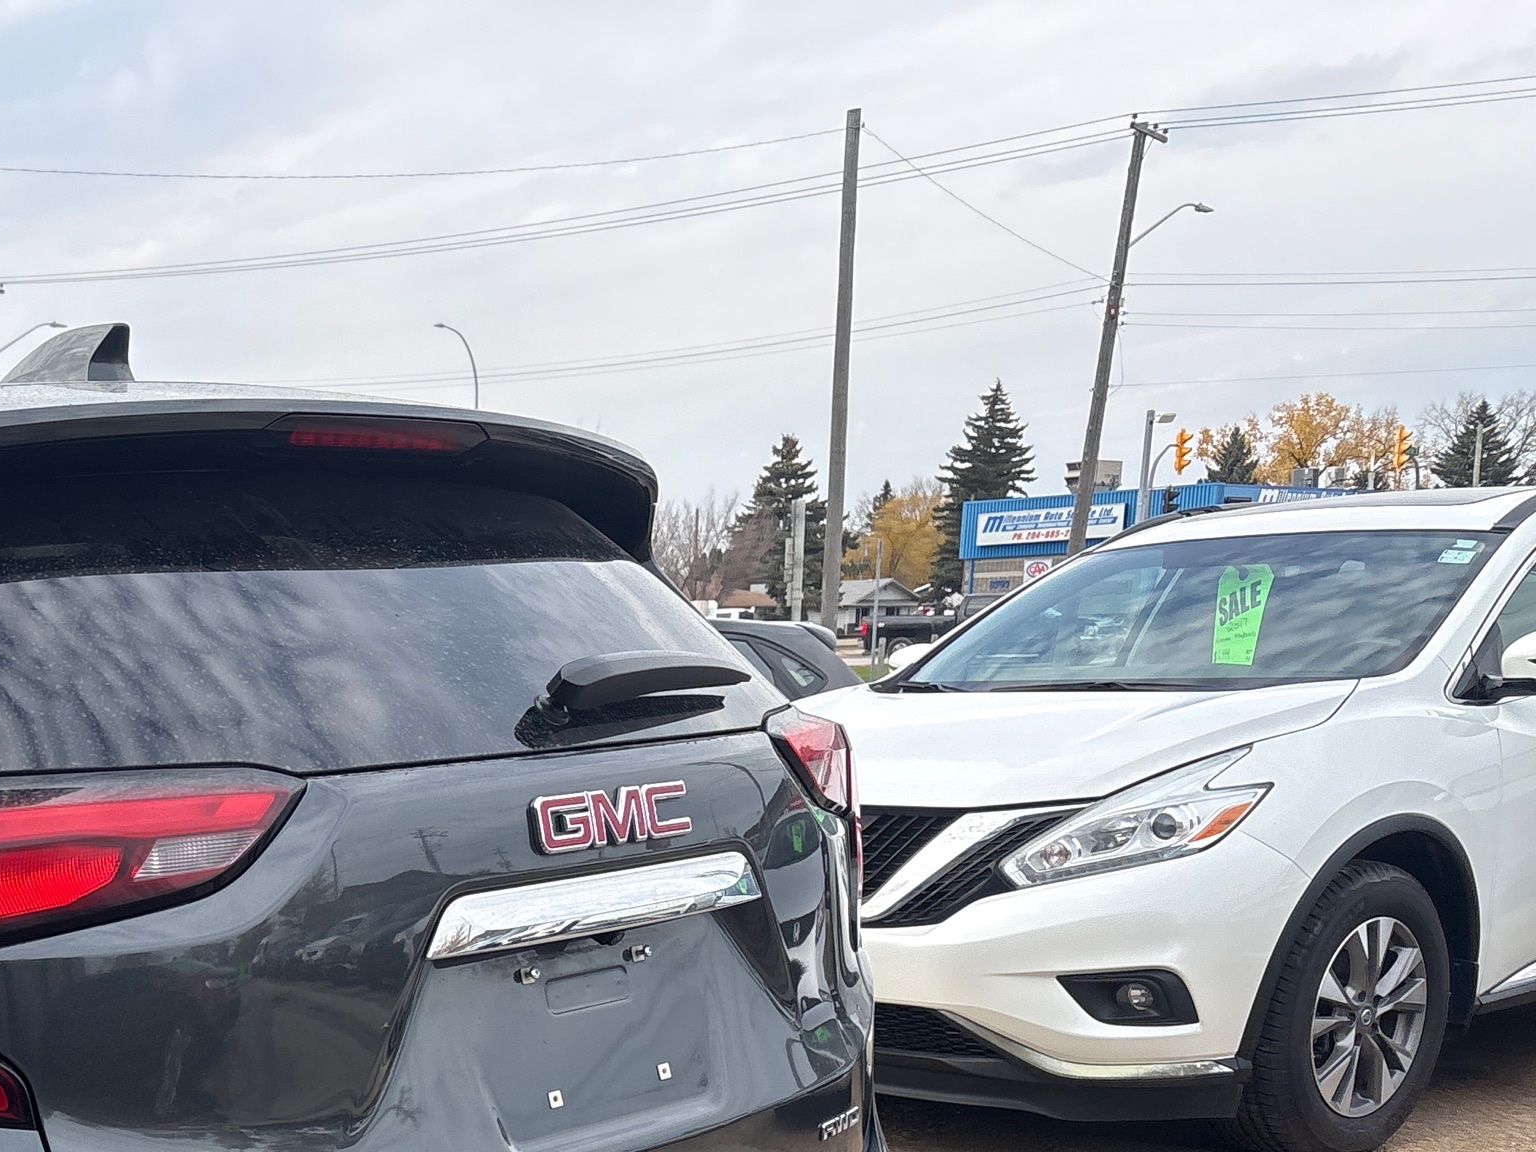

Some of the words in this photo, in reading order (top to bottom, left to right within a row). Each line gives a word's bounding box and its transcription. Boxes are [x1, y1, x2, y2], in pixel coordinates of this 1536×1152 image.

[1043, 510, 1064, 521] Auto
[1025, 529, 1070, 540] 204-885-2
[1218, 579, 1262, 627] SALE
[528, 780, 692, 856] GMC
[818, 1106, 859, 1141] AWD
